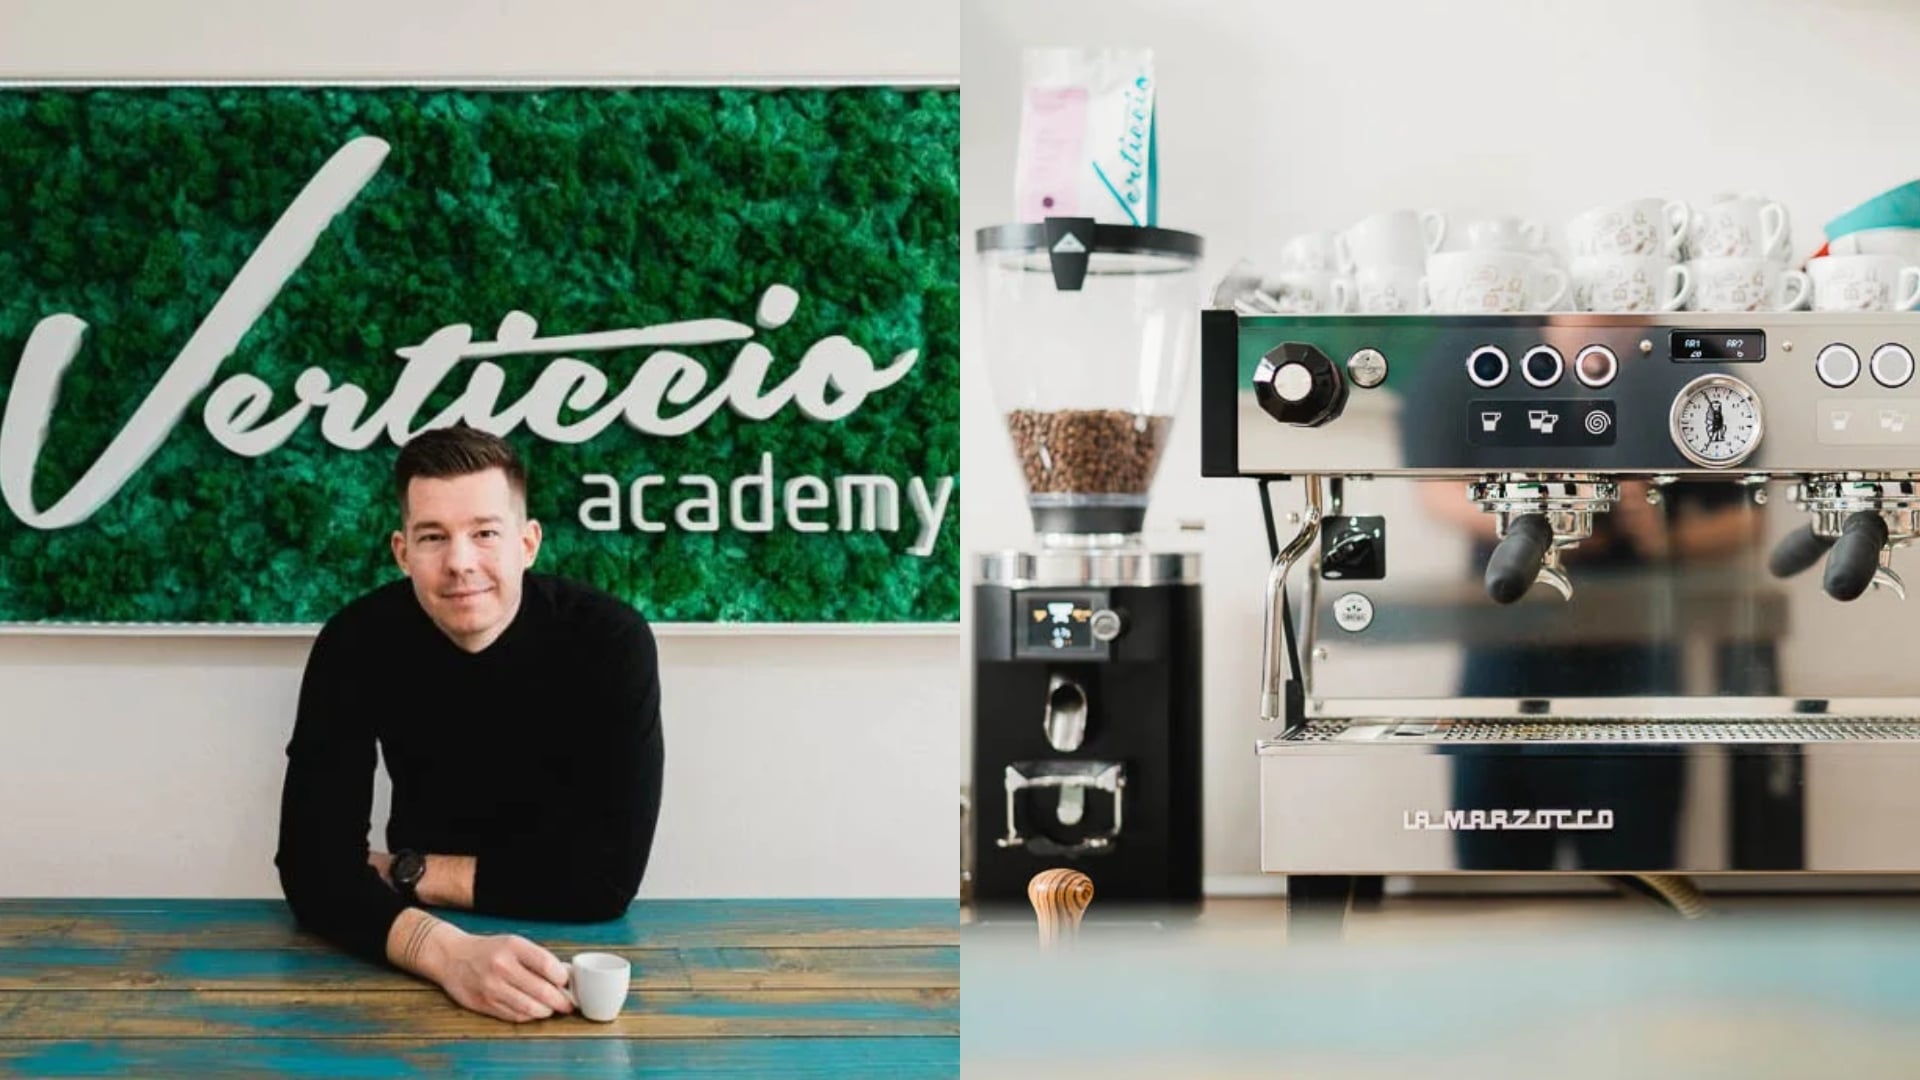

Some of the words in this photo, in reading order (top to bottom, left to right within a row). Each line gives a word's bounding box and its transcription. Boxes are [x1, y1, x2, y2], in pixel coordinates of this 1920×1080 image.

[0, 135, 918, 530] Verticcio
[579, 452, 955, 556] academy
[1404, 809, 1430, 830] LA
